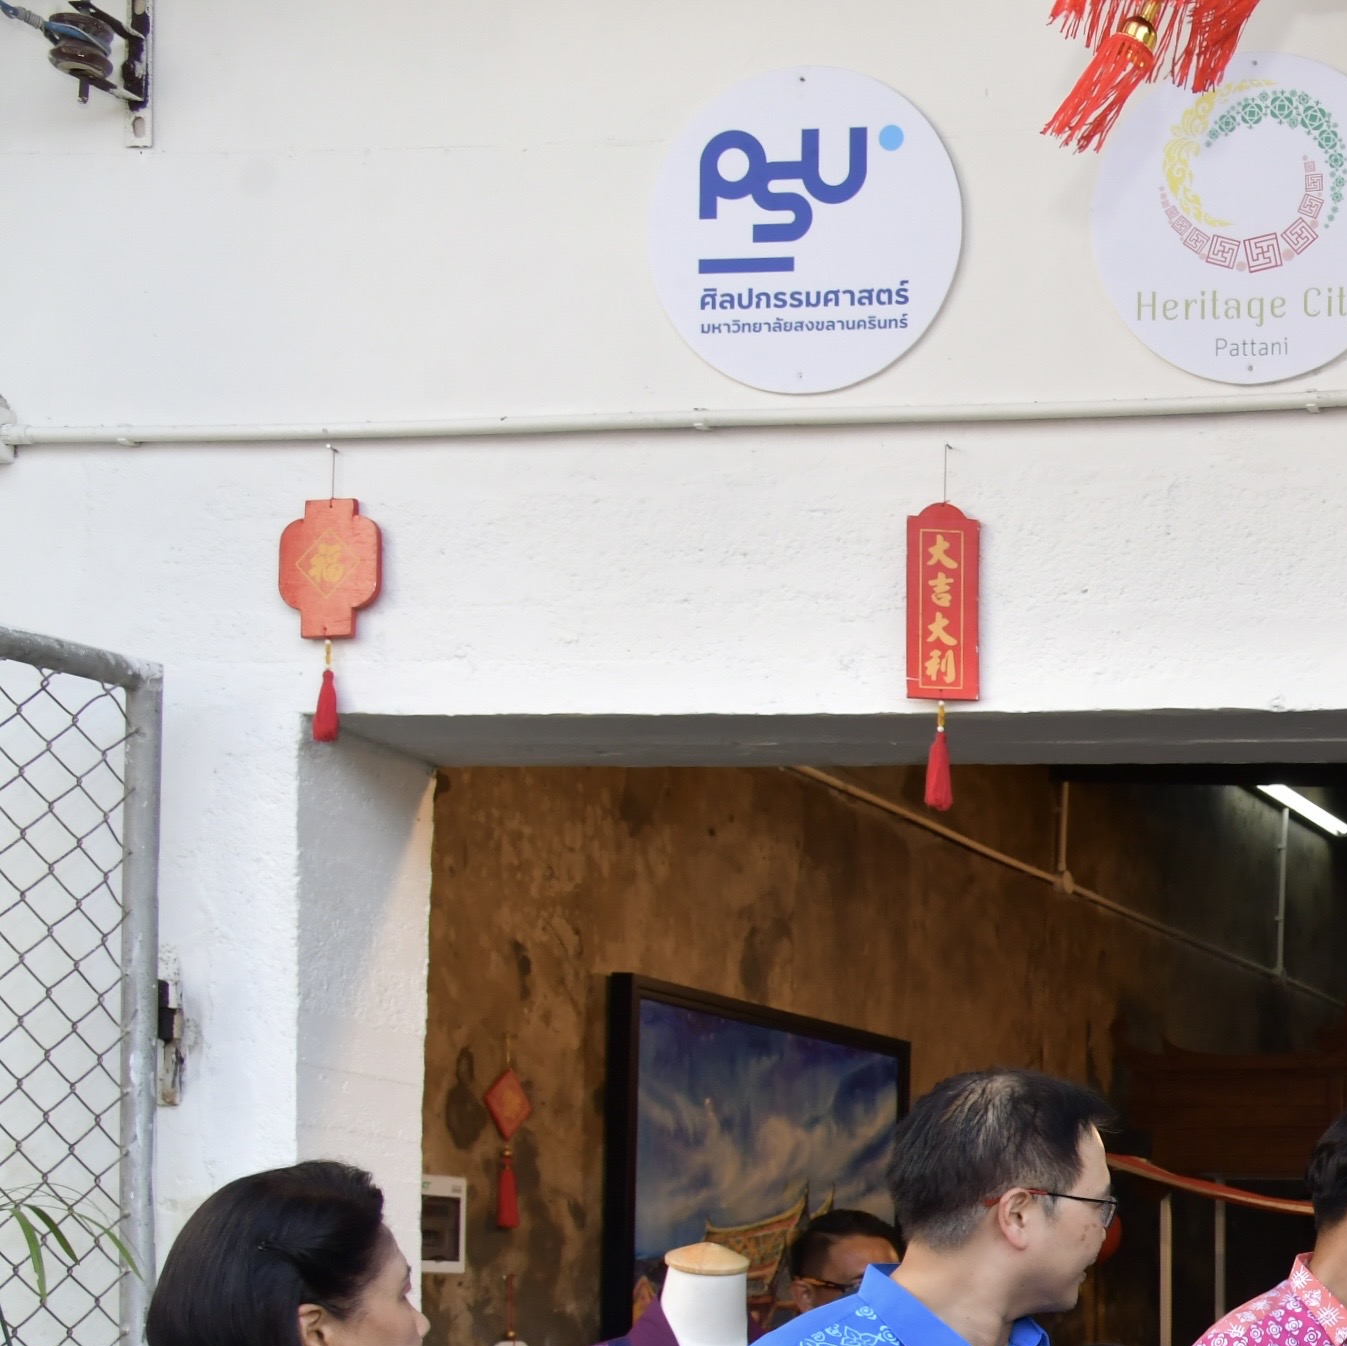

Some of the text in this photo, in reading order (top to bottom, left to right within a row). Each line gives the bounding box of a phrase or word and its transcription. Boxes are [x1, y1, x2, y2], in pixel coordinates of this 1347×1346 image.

[700, 280, 909, 311] ศิลปกรรมศาสตร์
[1136, 289, 1287, 328] Heritage
[700, 313, 908, 334] มหาวิทยาลัยสงขลานครินทร์
[1215, 337, 1288, 357] Pattani
[309, 543, 343, 583] 福
[925, 534, 959, 686] 大吉大利
